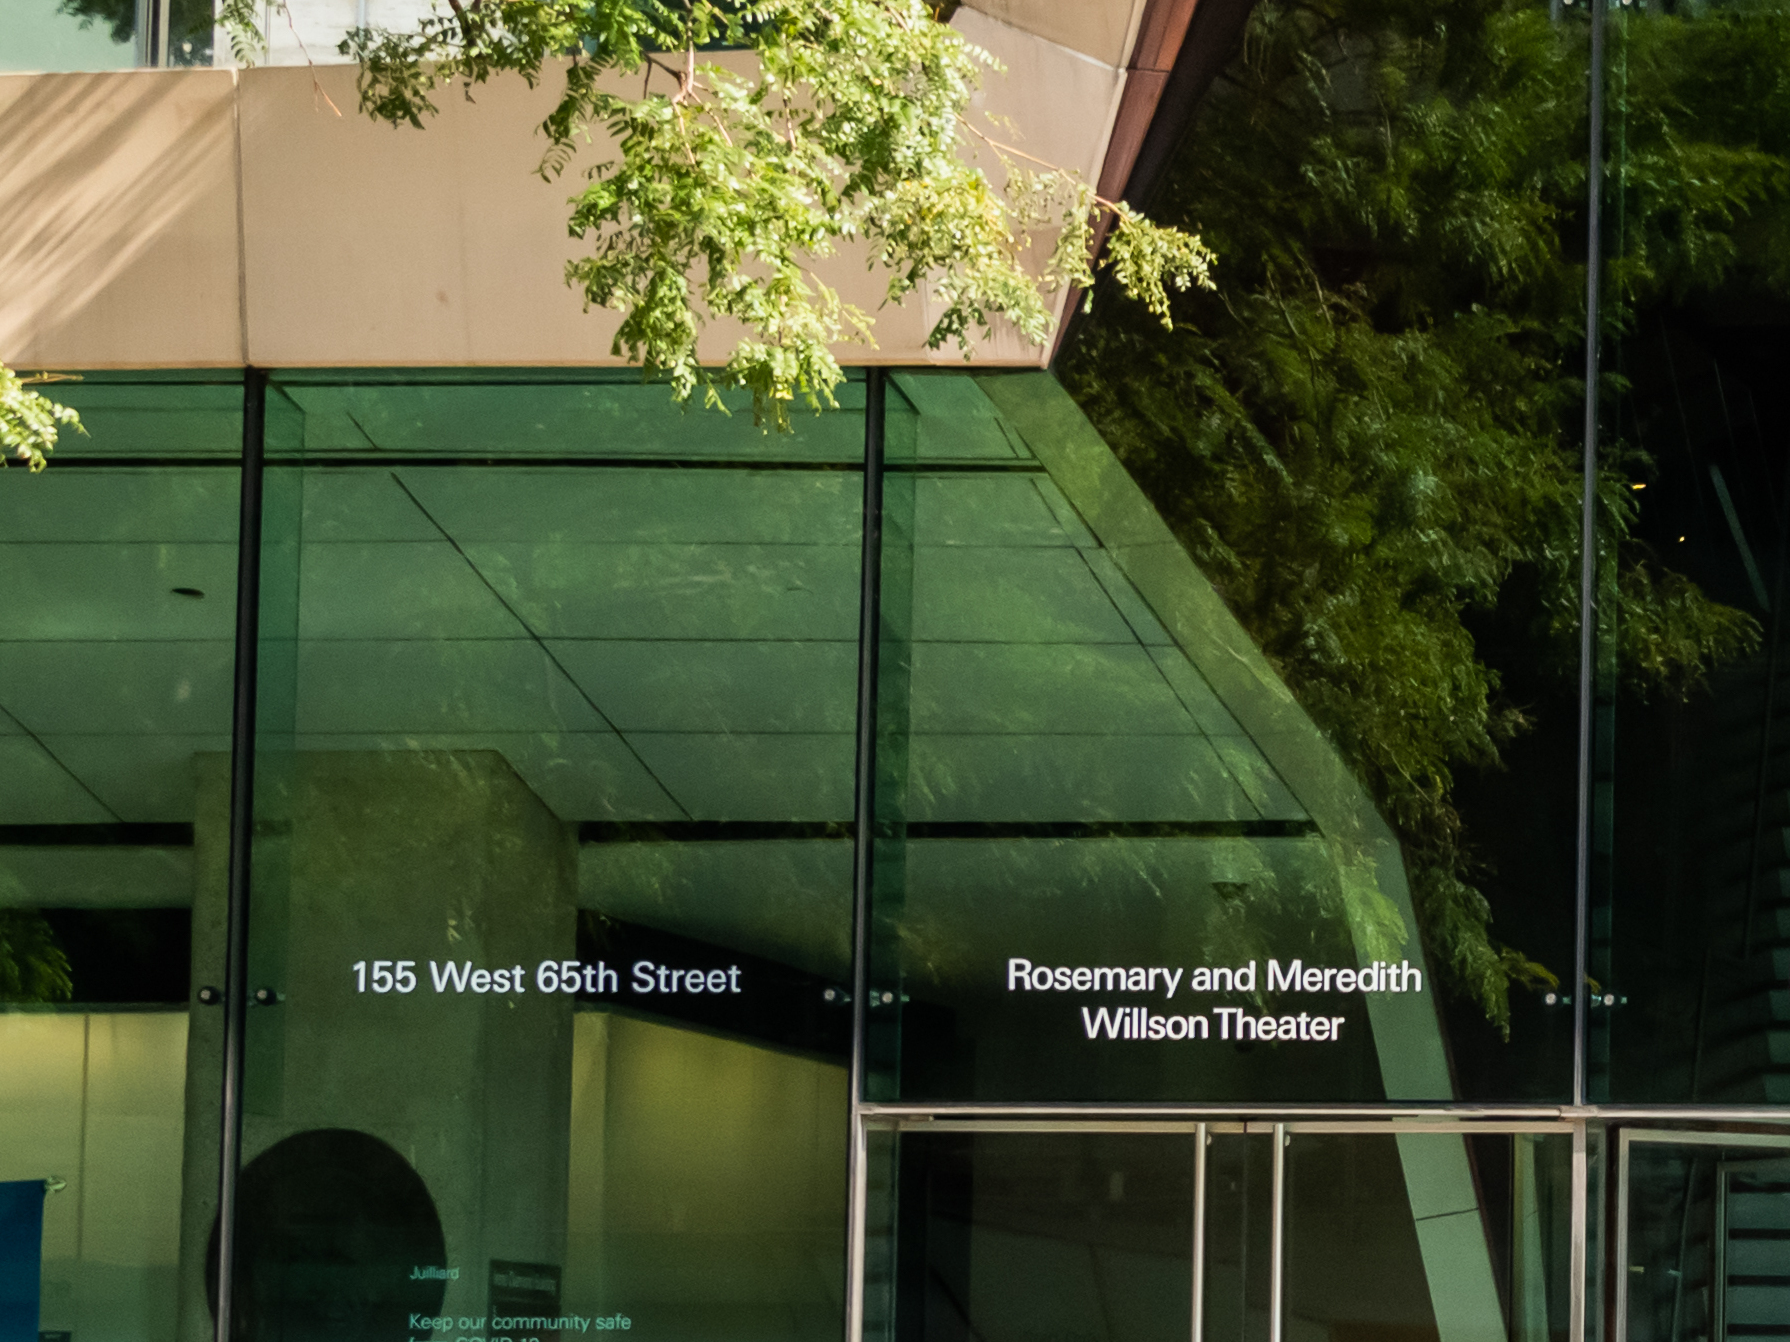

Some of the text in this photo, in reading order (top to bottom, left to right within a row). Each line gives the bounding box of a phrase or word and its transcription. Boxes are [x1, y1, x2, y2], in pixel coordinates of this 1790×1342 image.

[351, 960, 742, 994] 155 West 65th Street
[1006, 958, 1423, 999] Rosemary and Meredith
[1080, 1006, 1346, 1042] Willson Theater
[409, 1265, 460, 1281] Juilliard
[408, 1312, 632, 1334] Keep our community safe
